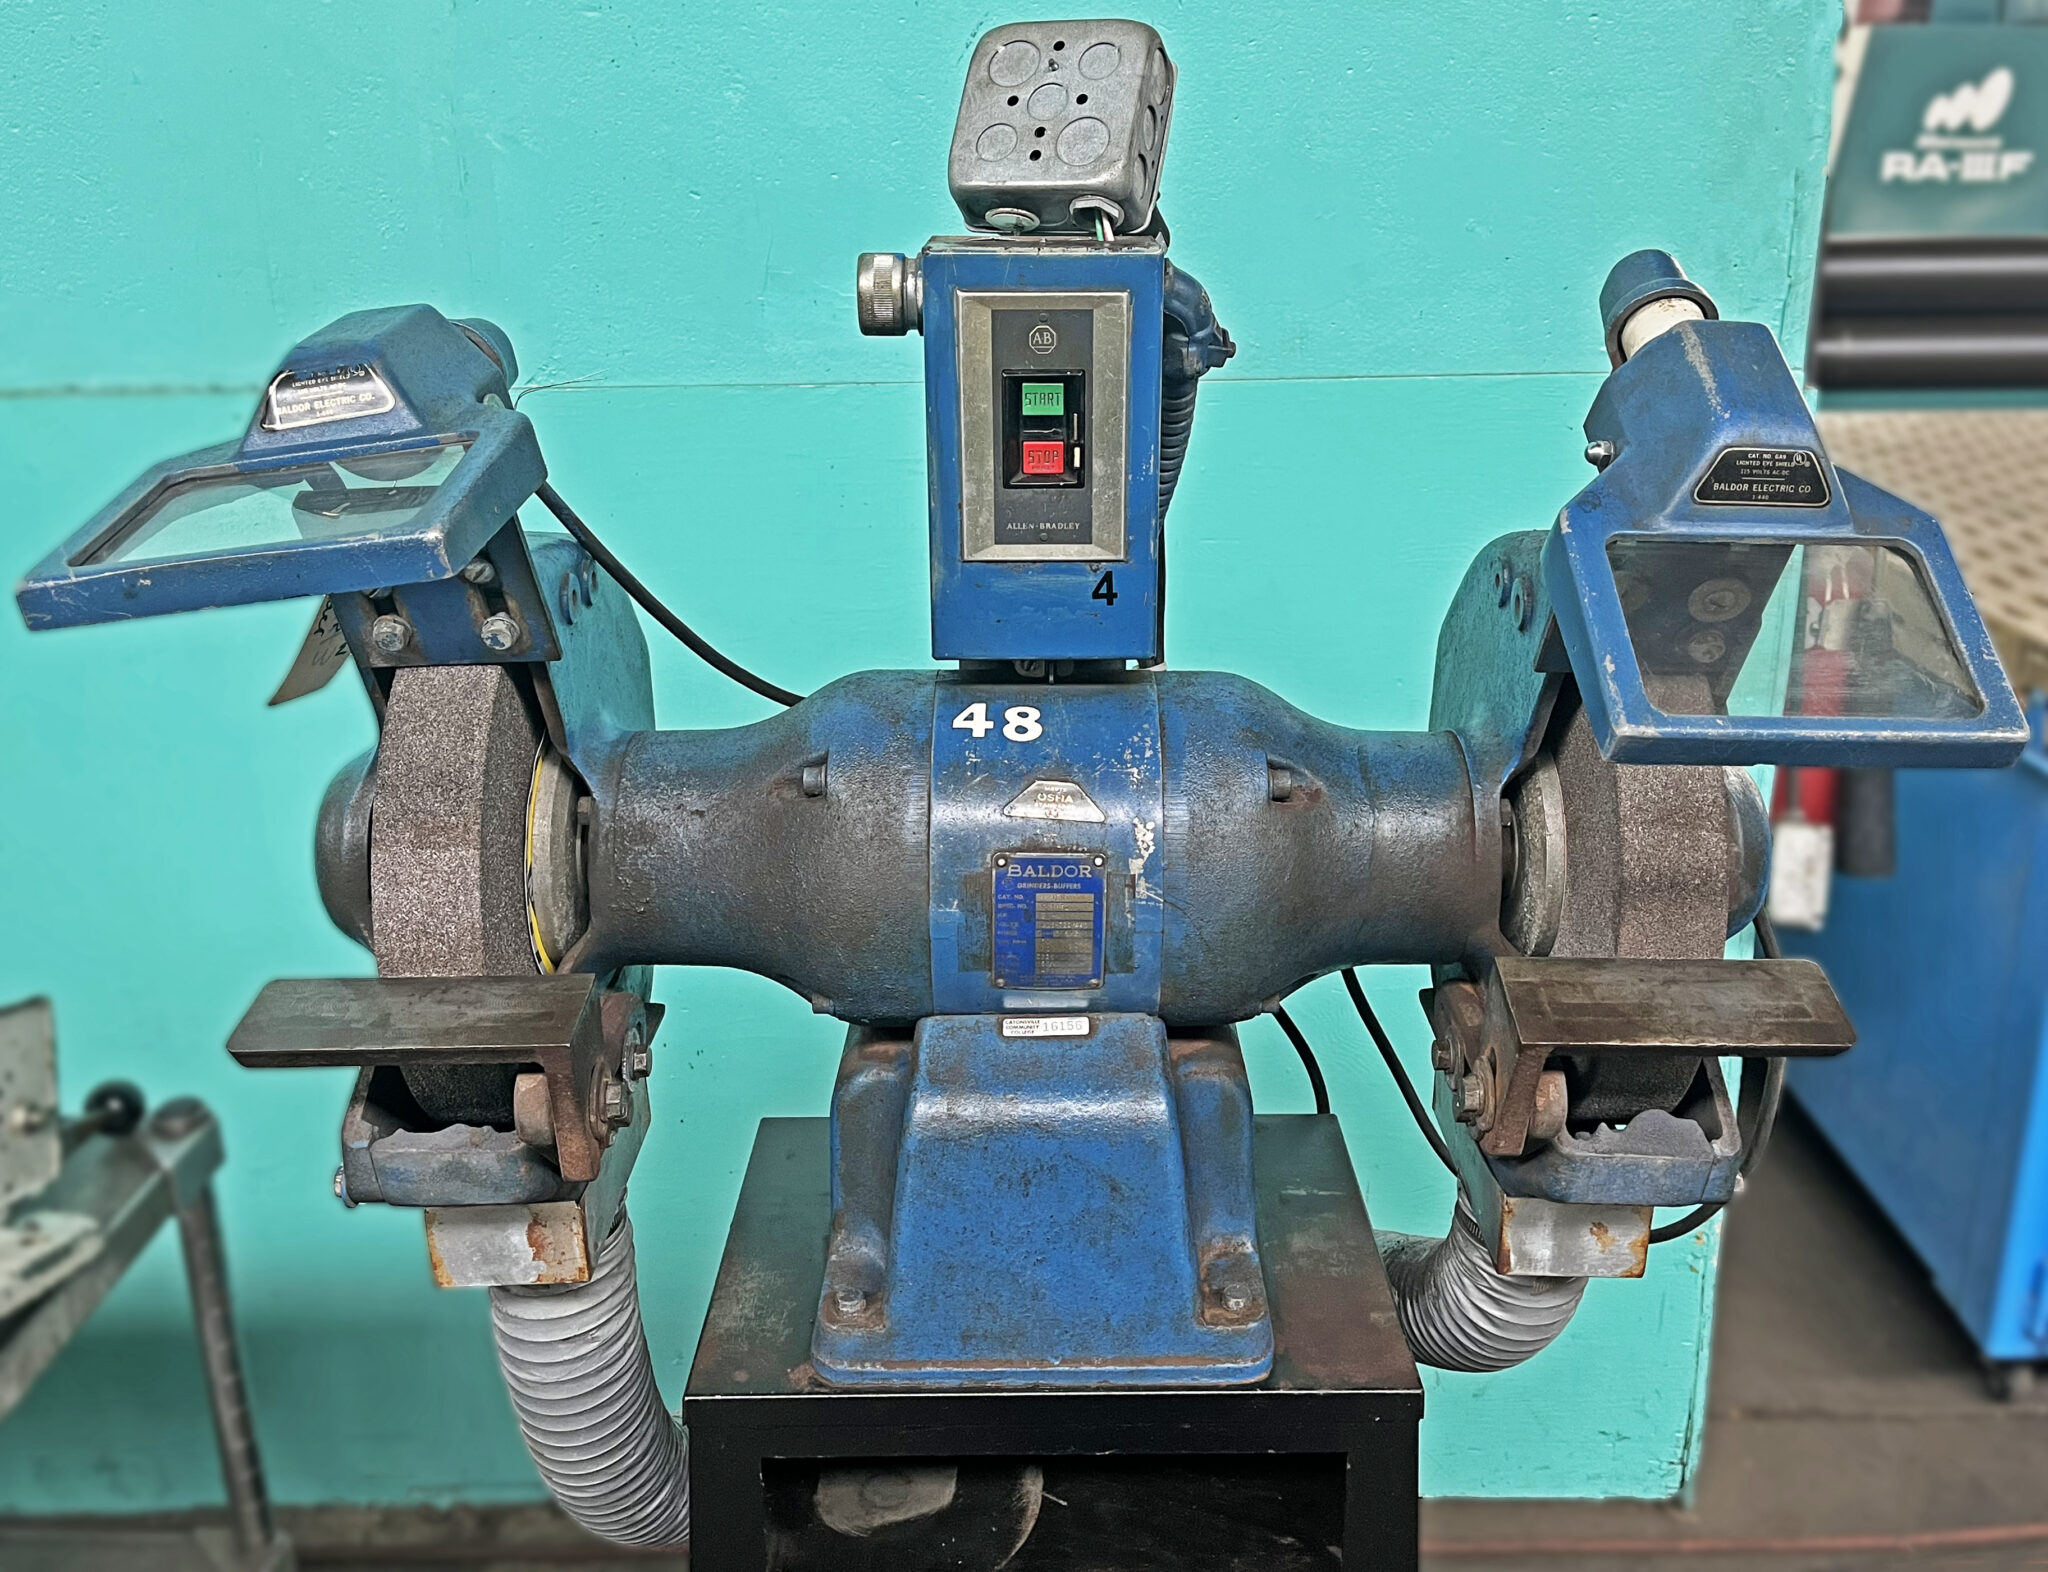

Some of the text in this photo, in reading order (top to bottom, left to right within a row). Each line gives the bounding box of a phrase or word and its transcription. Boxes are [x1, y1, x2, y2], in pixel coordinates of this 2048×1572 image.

[313, 394, 357, 410] ELECTRIC
[358, 391, 376, 402] CO.
[1024, 392, 1062, 407] START
[1028, 450, 1060, 465] STOP
[1713, 482, 1749, 492] BALDOR
[1752, 483, 1795, 493] ELECTRIC
[1092, 570, 1118, 606] 4
[952, 702, 1043, 742] 48
[1037, 792, 1074, 803] OSHA
[1007, 864, 1092, 878] BALDOR
